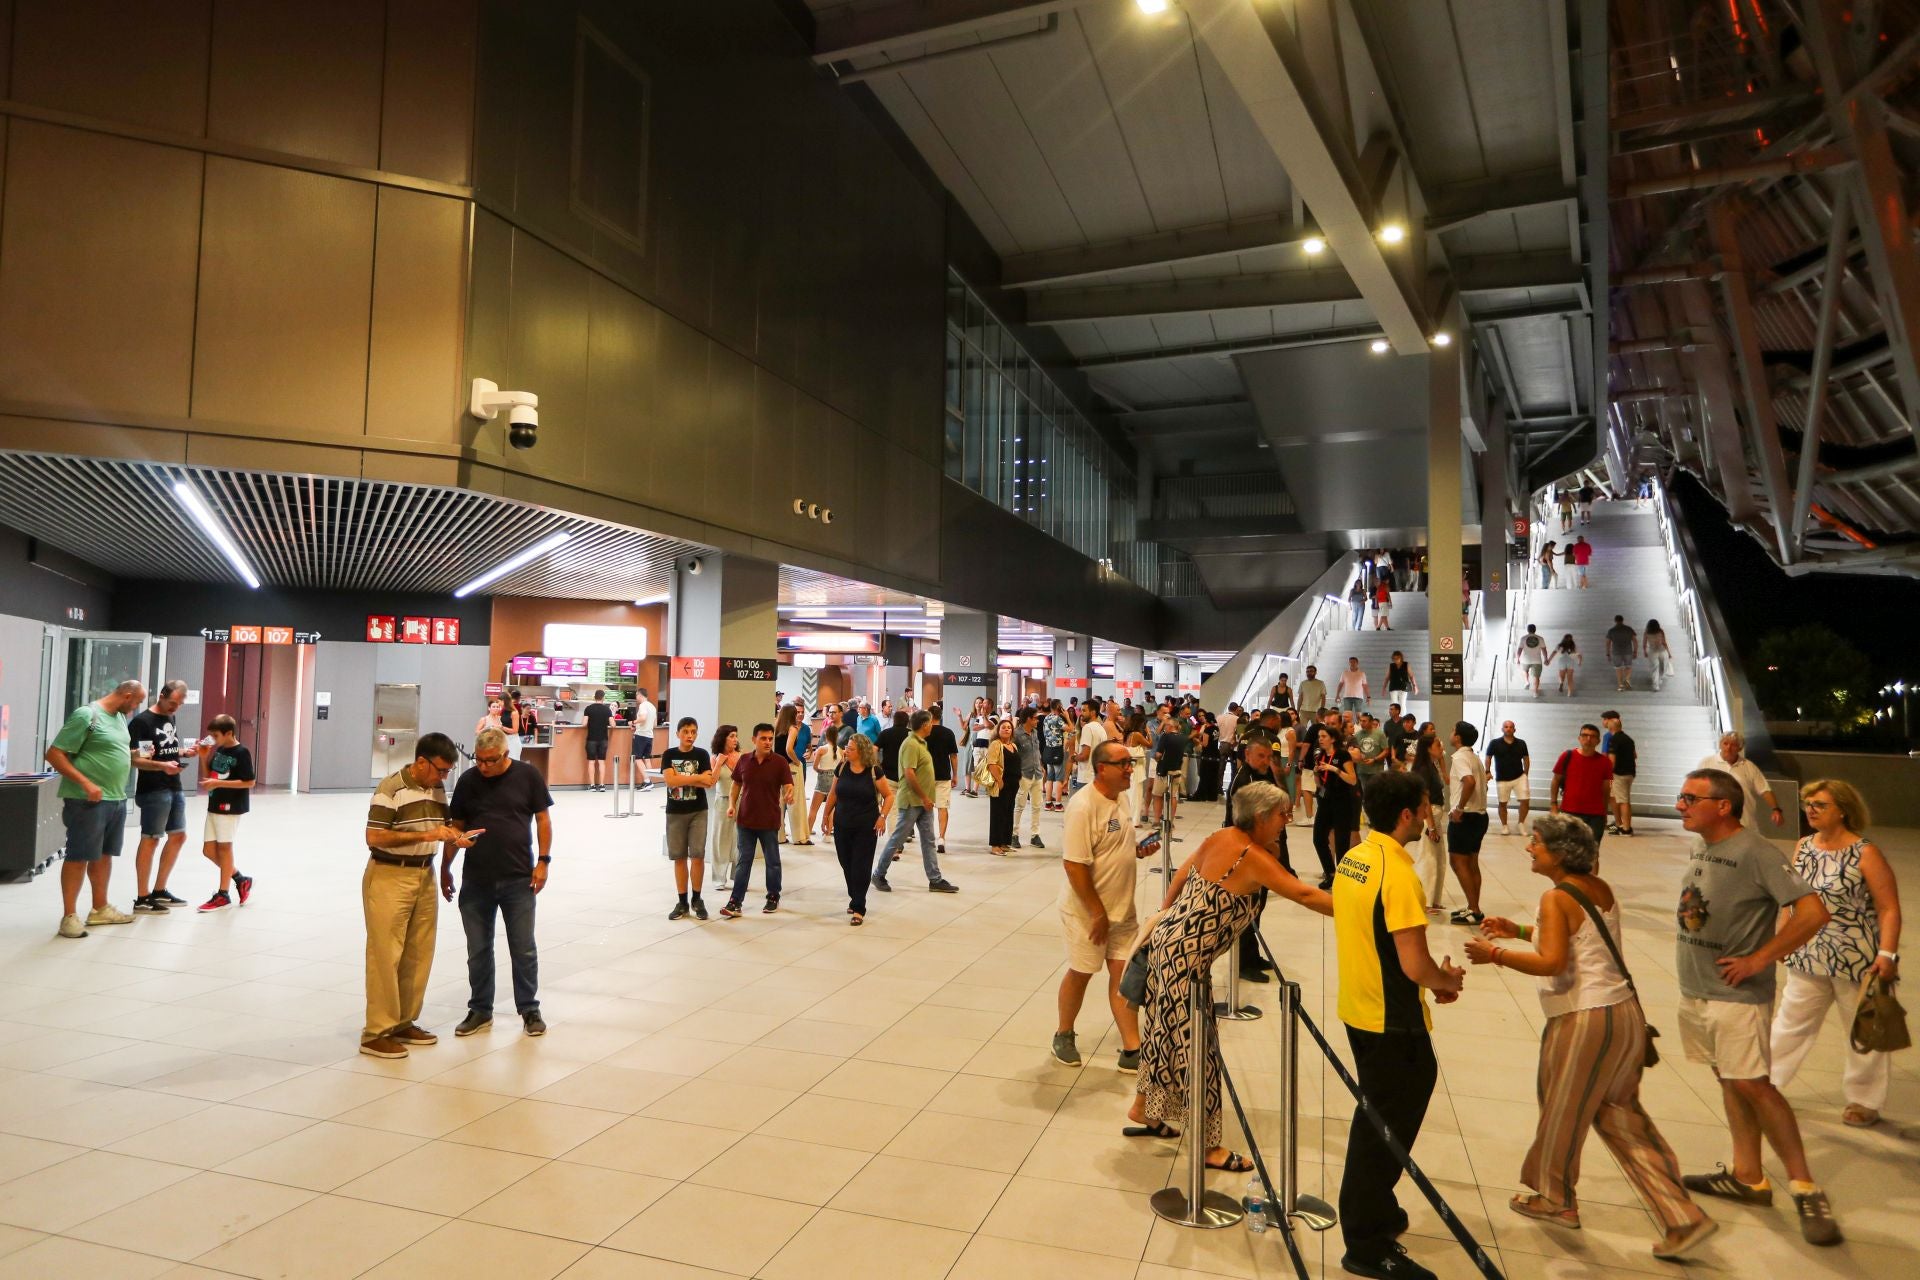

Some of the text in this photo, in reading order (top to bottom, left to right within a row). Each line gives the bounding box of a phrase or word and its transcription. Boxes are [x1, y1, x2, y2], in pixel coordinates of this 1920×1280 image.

[1515, 523, 1522, 531] 2
[234, 630, 257, 641] 106
[267, 631, 289, 643] 107
[693, 659, 705, 668] 106
[693, 668, 705, 678] 107
[1336, 866, 1368, 884] UXILIARES
